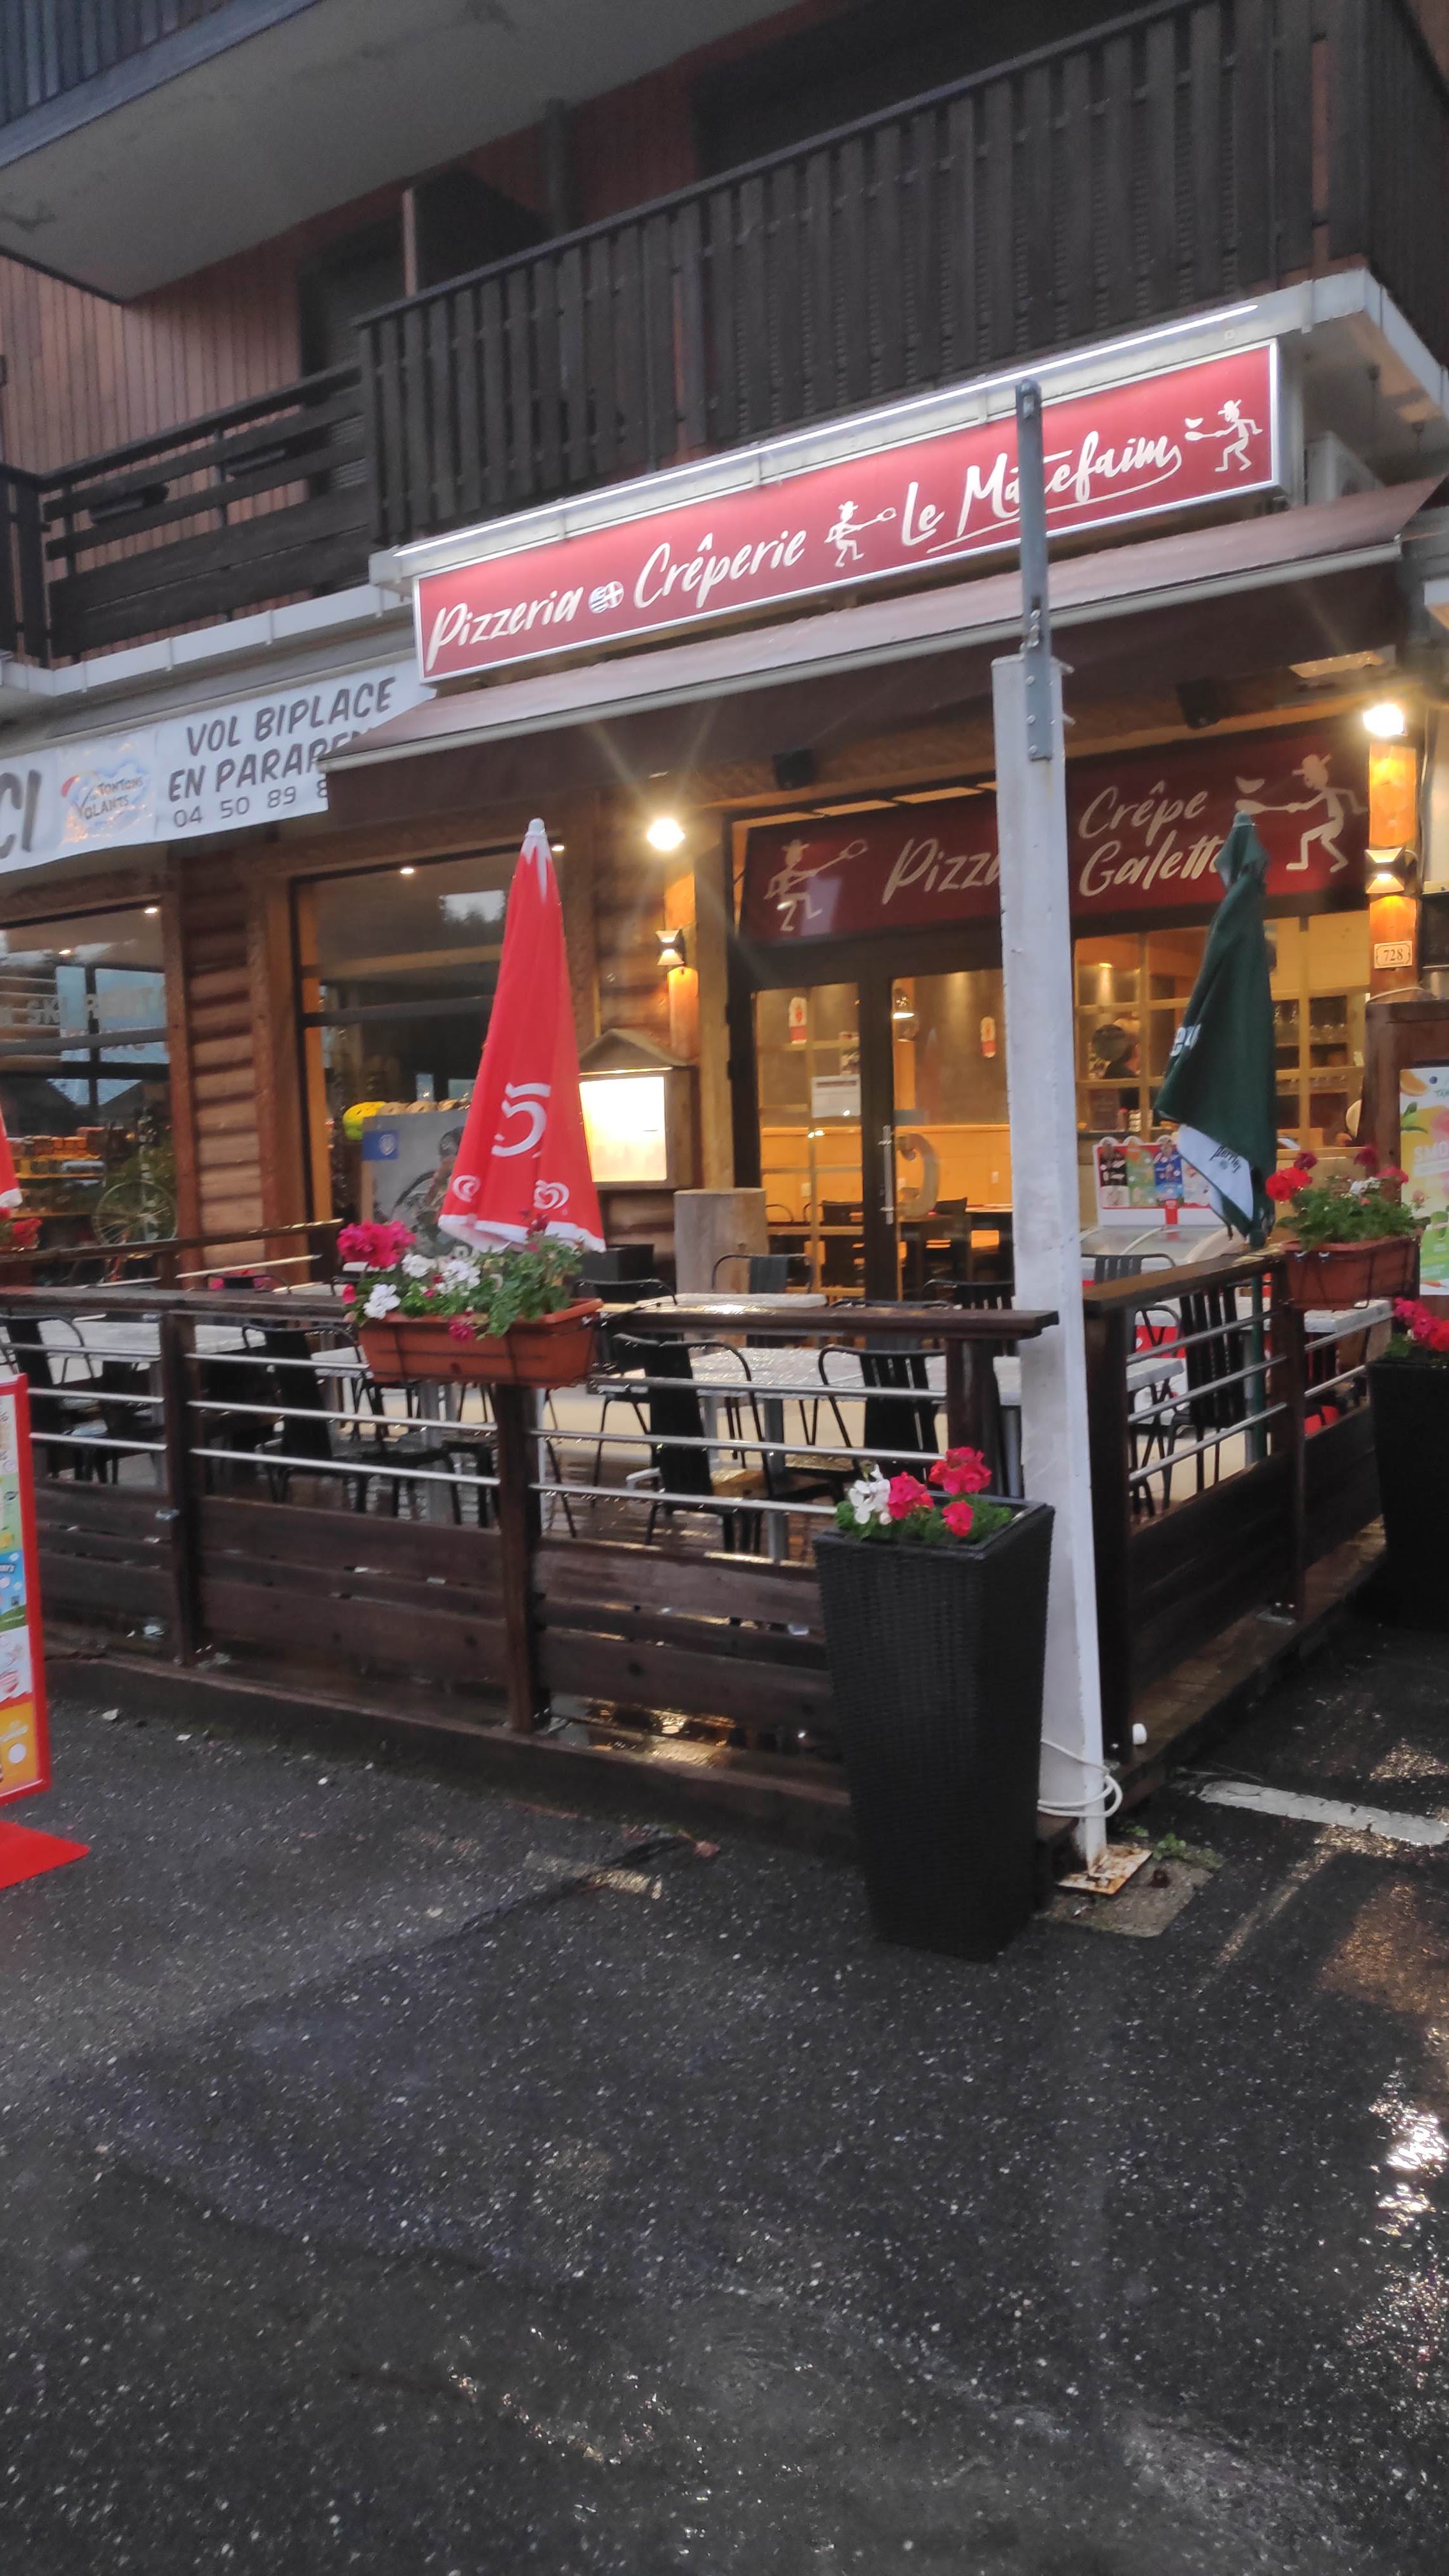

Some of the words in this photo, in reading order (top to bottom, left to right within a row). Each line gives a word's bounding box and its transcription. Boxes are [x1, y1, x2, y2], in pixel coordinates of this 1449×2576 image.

[425, 586, 583, 671] Pizzeria
[634, 531, 806, 609] Crêperie
[901, 481, 945, 547] Le
[187, 719, 241, 756] VOL
[255, 676, 397, 741] BIPLACE
[168, 765, 206, 802] EN
[174, 806, 203, 828] 04
[220, 796, 250, 820] 50
[268, 786, 296, 809] 89
[1078, 779, 1209, 847] Crêpe
[1383, 948, 1404, 962] 728
